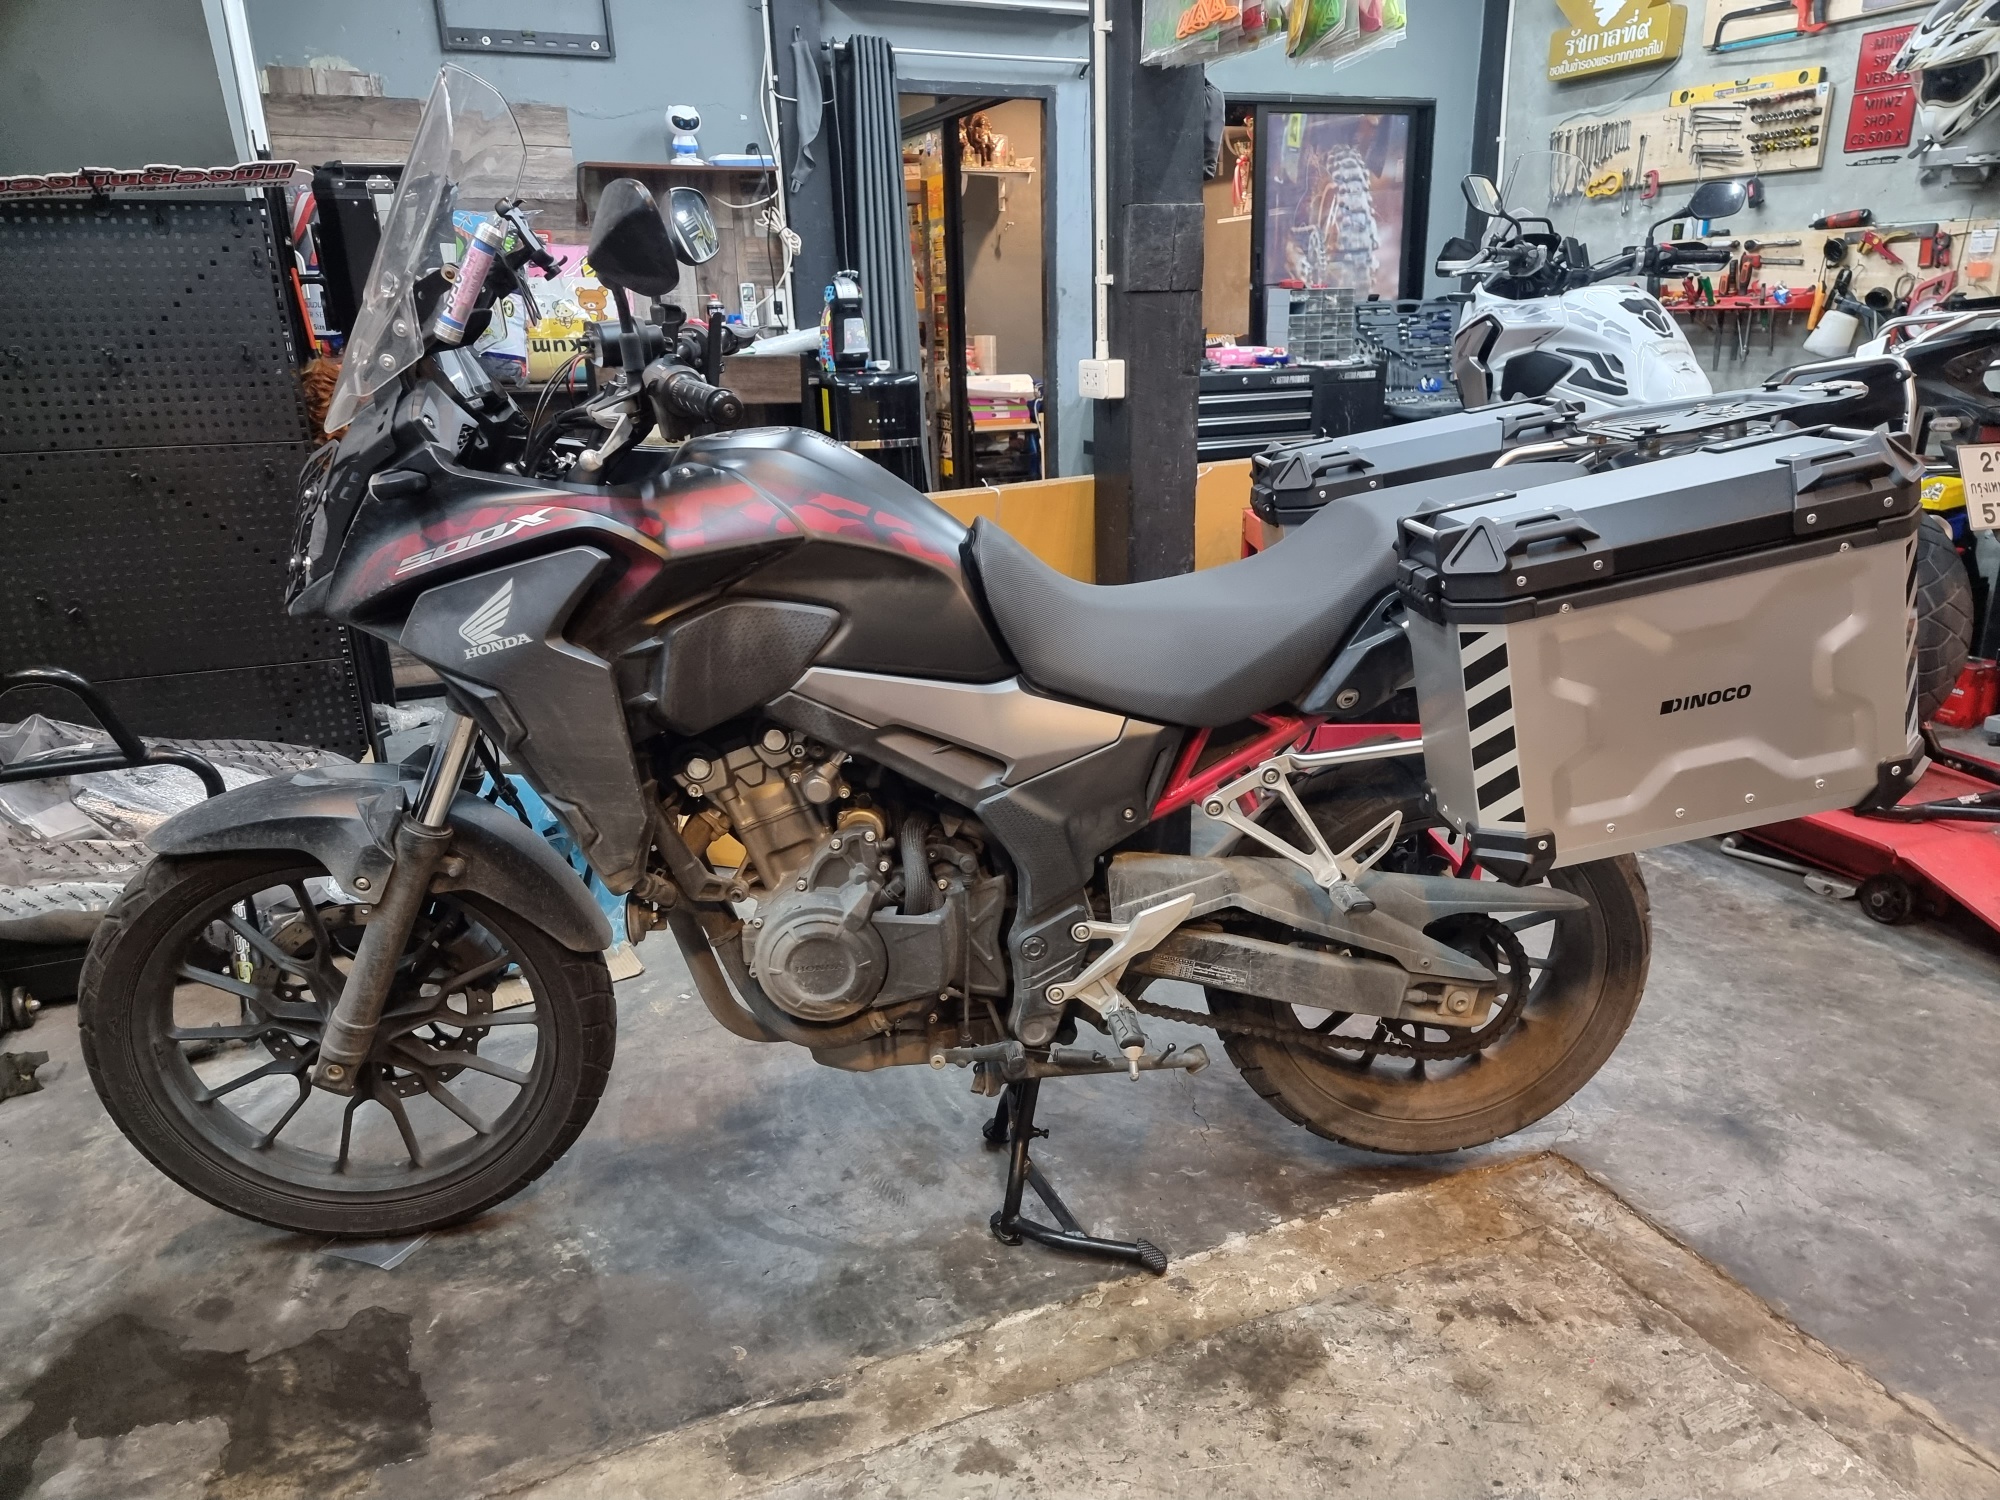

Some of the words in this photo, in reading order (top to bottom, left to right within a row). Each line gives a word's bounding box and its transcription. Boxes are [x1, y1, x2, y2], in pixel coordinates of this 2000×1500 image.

[1865, 95, 1903, 110] MIIWZ
[1863, 112, 1896, 128] SHOP
[1851, 133, 1866, 146] CB
[1868, 130, 1892, 144] 500
[1895, 128, 1905, 142] X
[1982, 503, 2000, 524] 5
[397, 507, 555, 573] 500X
[464, 633, 533, 660] HONDA
[1660, 684, 1752, 715] DINOCO
